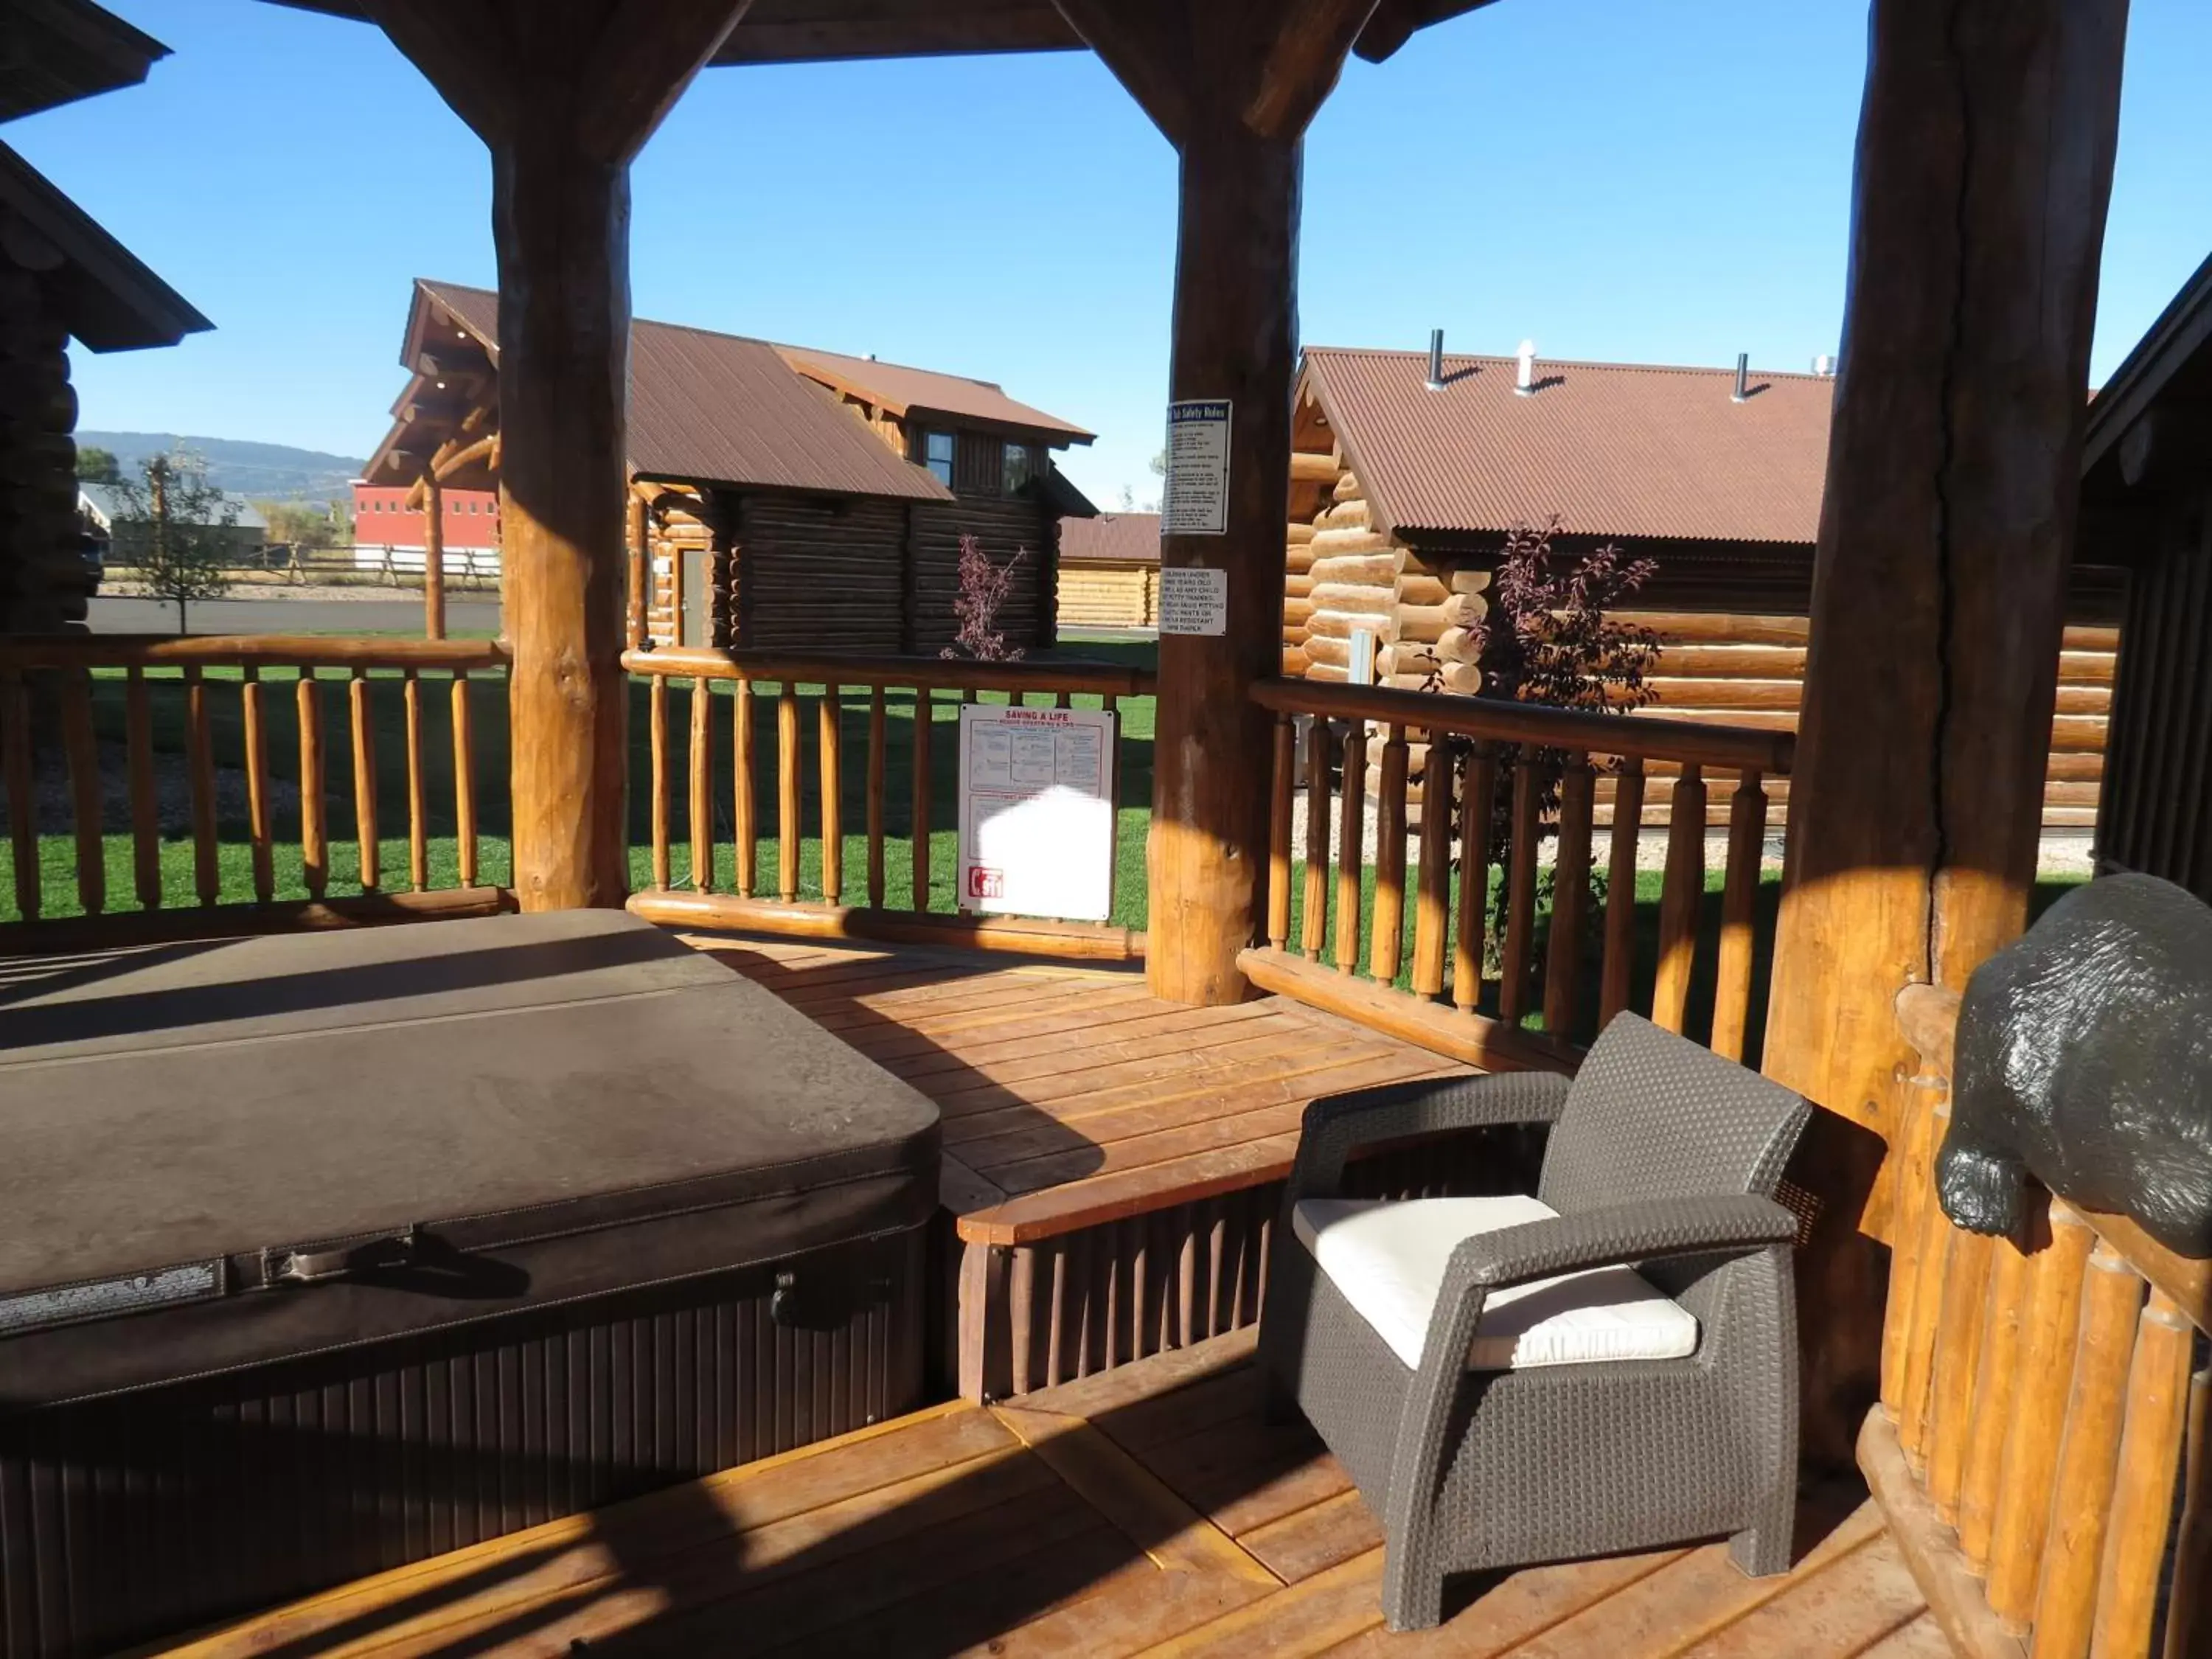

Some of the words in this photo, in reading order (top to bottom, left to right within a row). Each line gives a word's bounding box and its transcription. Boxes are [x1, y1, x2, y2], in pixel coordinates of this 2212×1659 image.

[1183, 406, 1201, 420] Safety
[1204, 406, 1224, 417] Rules
[1006, 710, 1037, 720] SAVING
[1040, 712, 1046, 720] A
[1049, 712, 1068, 721] LIFE
